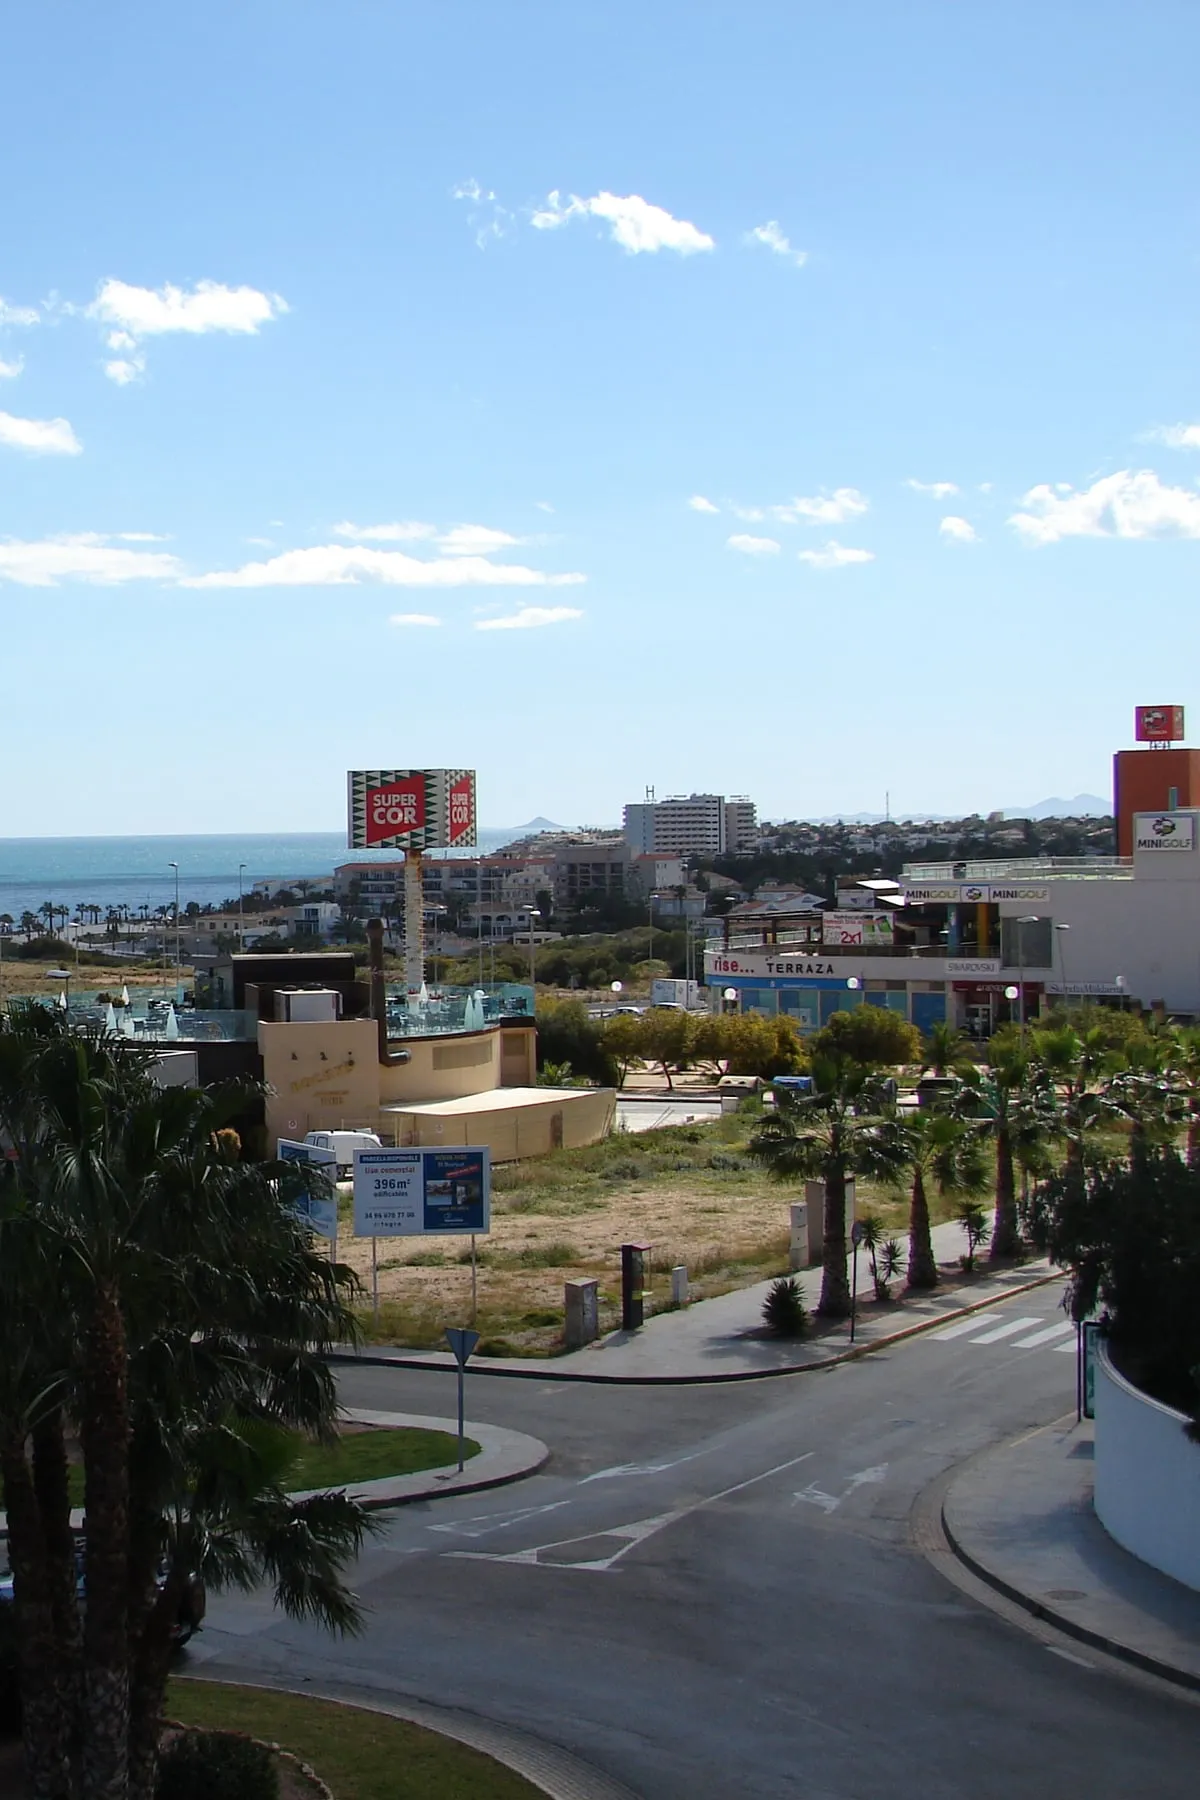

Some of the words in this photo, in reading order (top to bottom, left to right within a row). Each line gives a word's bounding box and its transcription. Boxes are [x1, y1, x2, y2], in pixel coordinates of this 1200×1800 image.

[373, 793, 417, 807] SUPER
[451, 793, 469, 806] SUPER
[372, 807, 418, 825] COR
[451, 806, 469, 824] COR
[1137, 838, 1192, 849] MINIGOLF
[906, 889, 959, 899] MINIGOLF
[992, 889, 1048, 899] MINIGOLF
[840, 930, 862, 944] 2x1
[766, 962, 835, 975] TERRAZA
